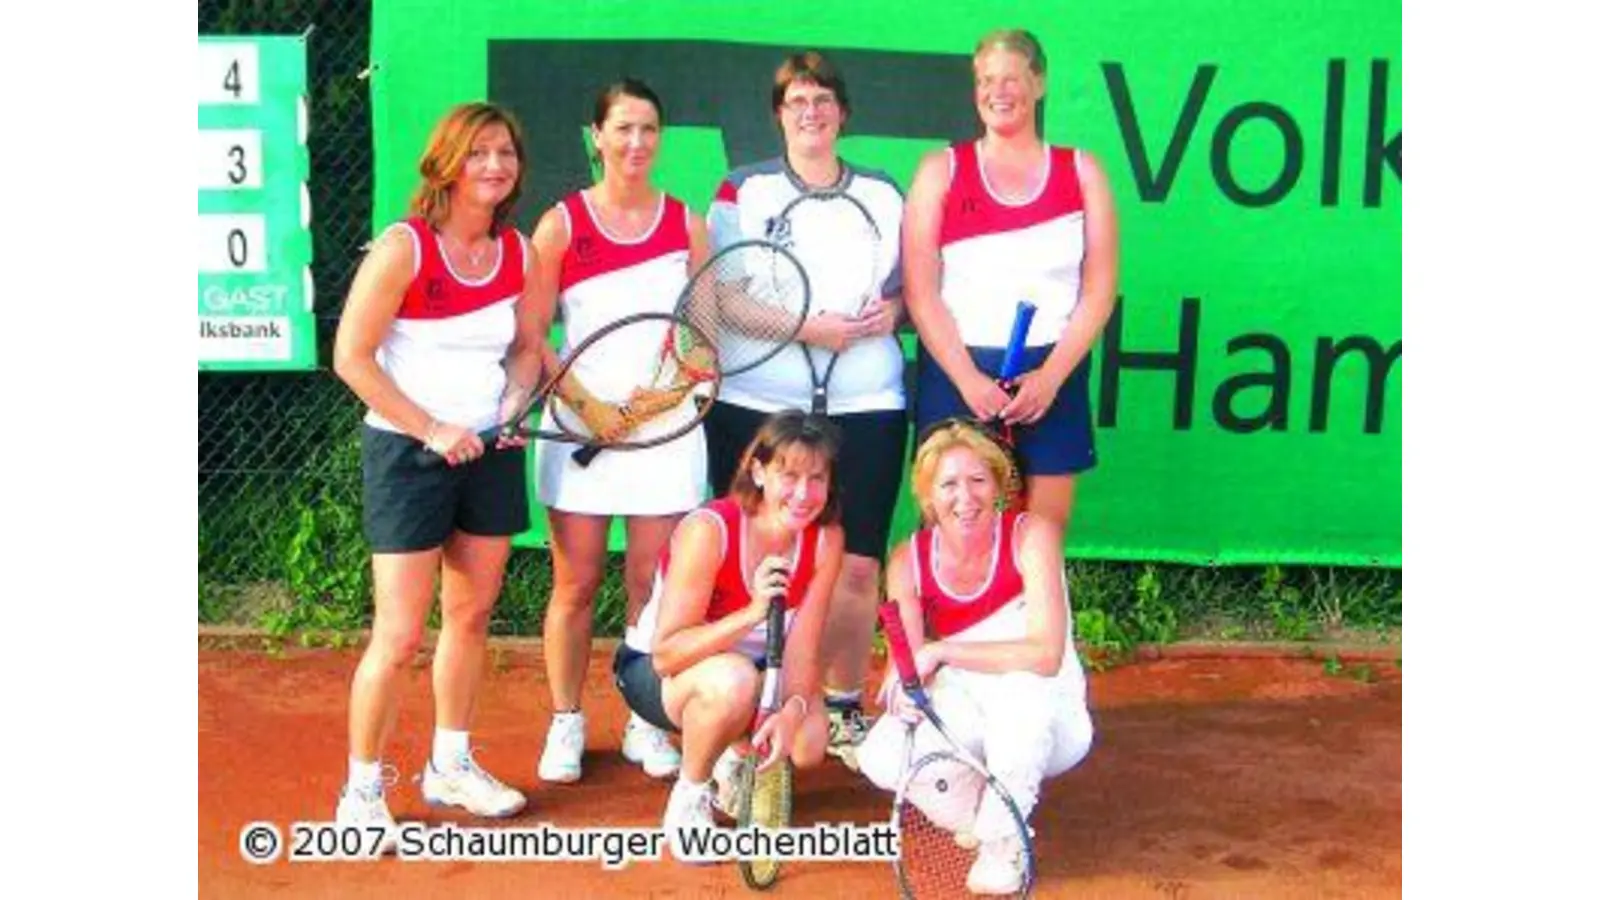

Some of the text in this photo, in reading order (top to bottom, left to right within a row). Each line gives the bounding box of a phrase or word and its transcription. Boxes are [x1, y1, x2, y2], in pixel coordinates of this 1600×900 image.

[223, 59, 243, 97] 4
[226, 145, 247, 184] 3
[227, 228, 248, 267] 0
